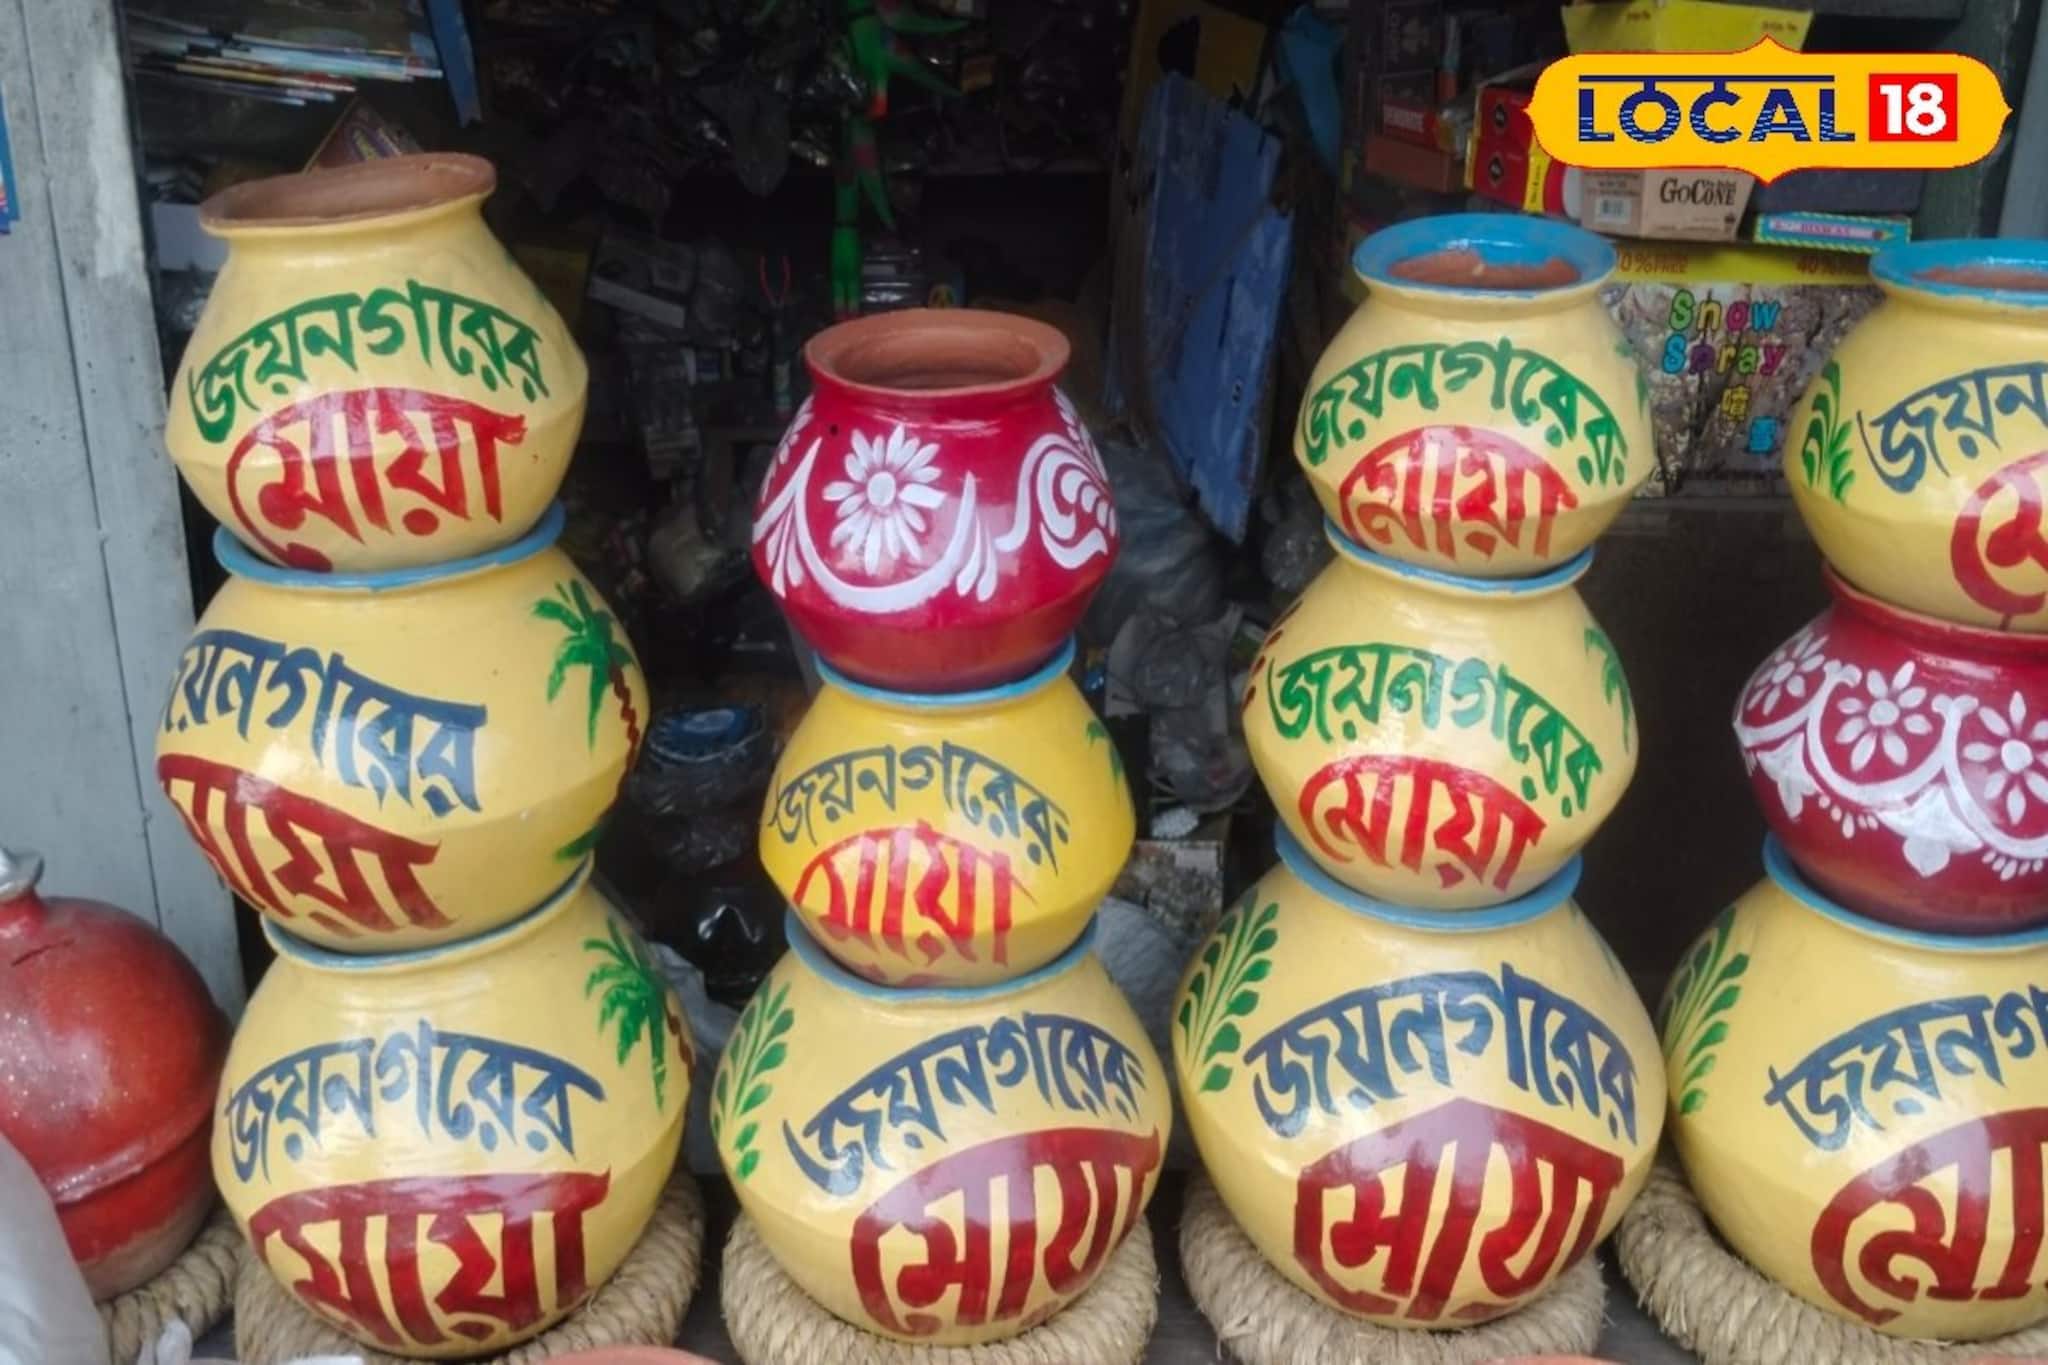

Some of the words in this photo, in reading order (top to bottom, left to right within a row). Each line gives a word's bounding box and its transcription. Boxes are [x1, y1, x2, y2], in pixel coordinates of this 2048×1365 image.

[188, 279, 549, 443] জয়নগরের
[1662, 333, 1788, 376] Spray
[1669, 289, 1782, 332] Snow
[227, 387, 528, 573] মোয়া
[1302, 335, 1628, 486] জয়নগরের
[1339, 424, 1579, 561] মোয়া
[165, 629, 487, 817] য়নগরের
[1268, 643, 1602, 818] জয়নগরের
[766, 740, 1069, 876] জয়নগরের
[1298, 754, 1547, 892] মোয়া
[225, 1018, 608, 1183] জয়নগরের
[783, 1011, 1146, 1197] জয়নগরের
[1243, 962, 1640, 1146] জয়নগরের
